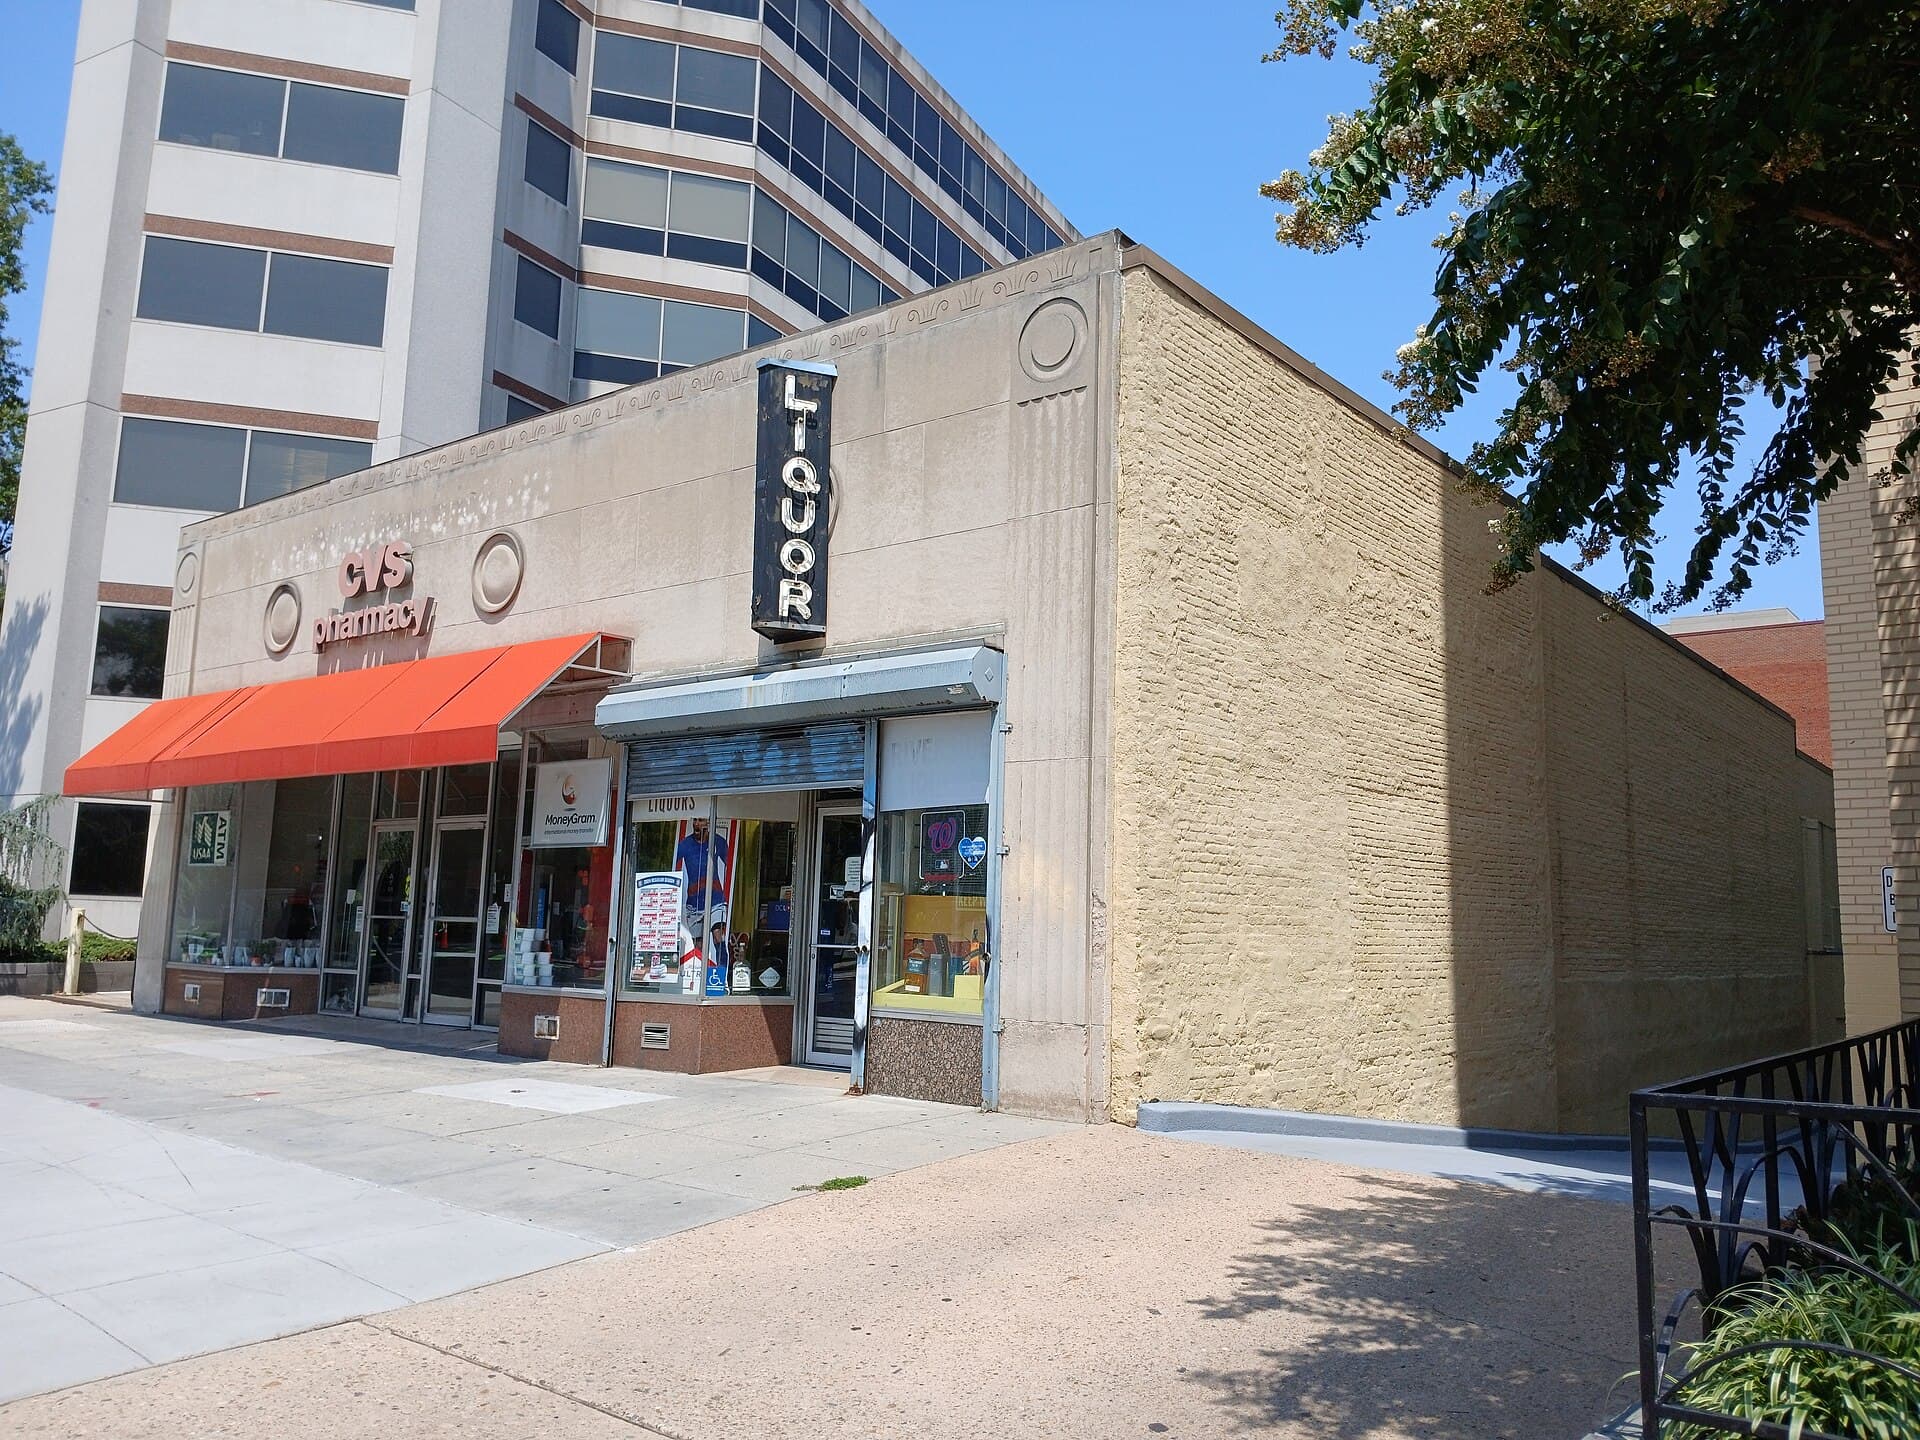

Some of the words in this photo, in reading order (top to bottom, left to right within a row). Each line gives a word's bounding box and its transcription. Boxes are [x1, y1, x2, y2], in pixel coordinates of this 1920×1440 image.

[780, 375, 821, 620] LIQUOR
[338, 540, 412, 598] CVS
[312, 598, 434, 654] pharmacy
[216, 816, 228, 860] ATM
[545, 812, 596, 828] MoneyGram
[193, 847, 211, 860] USAA
[680, 970, 703, 978] ULTR
